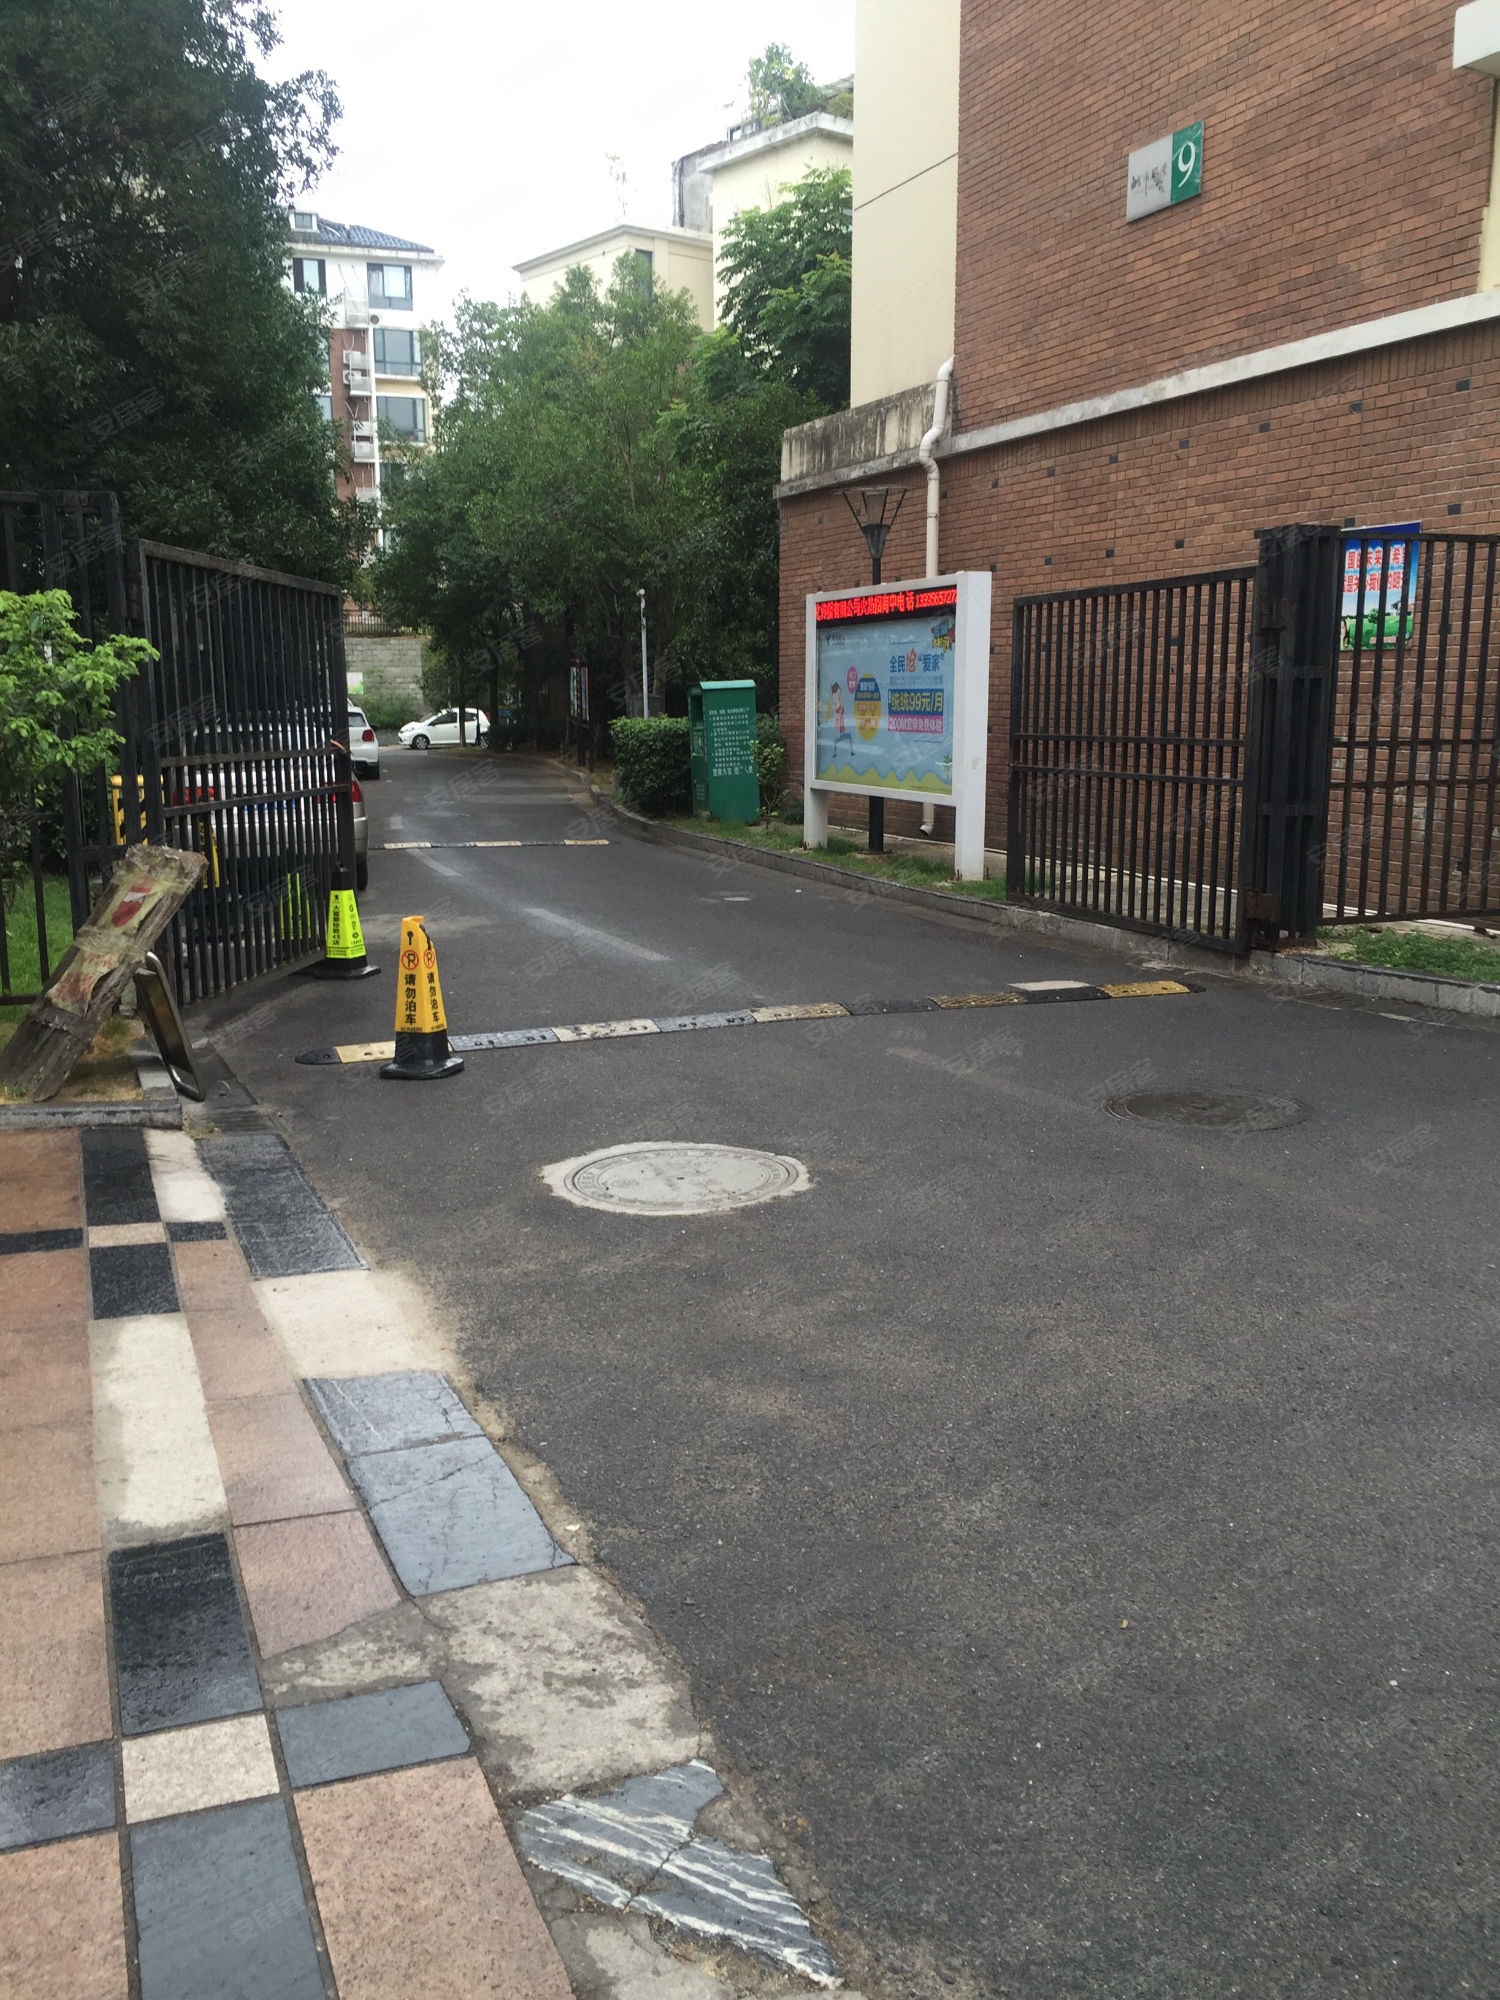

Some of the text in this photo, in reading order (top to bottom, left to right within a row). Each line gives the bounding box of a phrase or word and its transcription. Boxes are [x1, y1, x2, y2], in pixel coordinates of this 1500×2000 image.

[1178, 141, 1196, 188] 9
[404, 973, 417, 1025] 请勿泊车
[427, 972, 440, 1023] 请勿泊车
